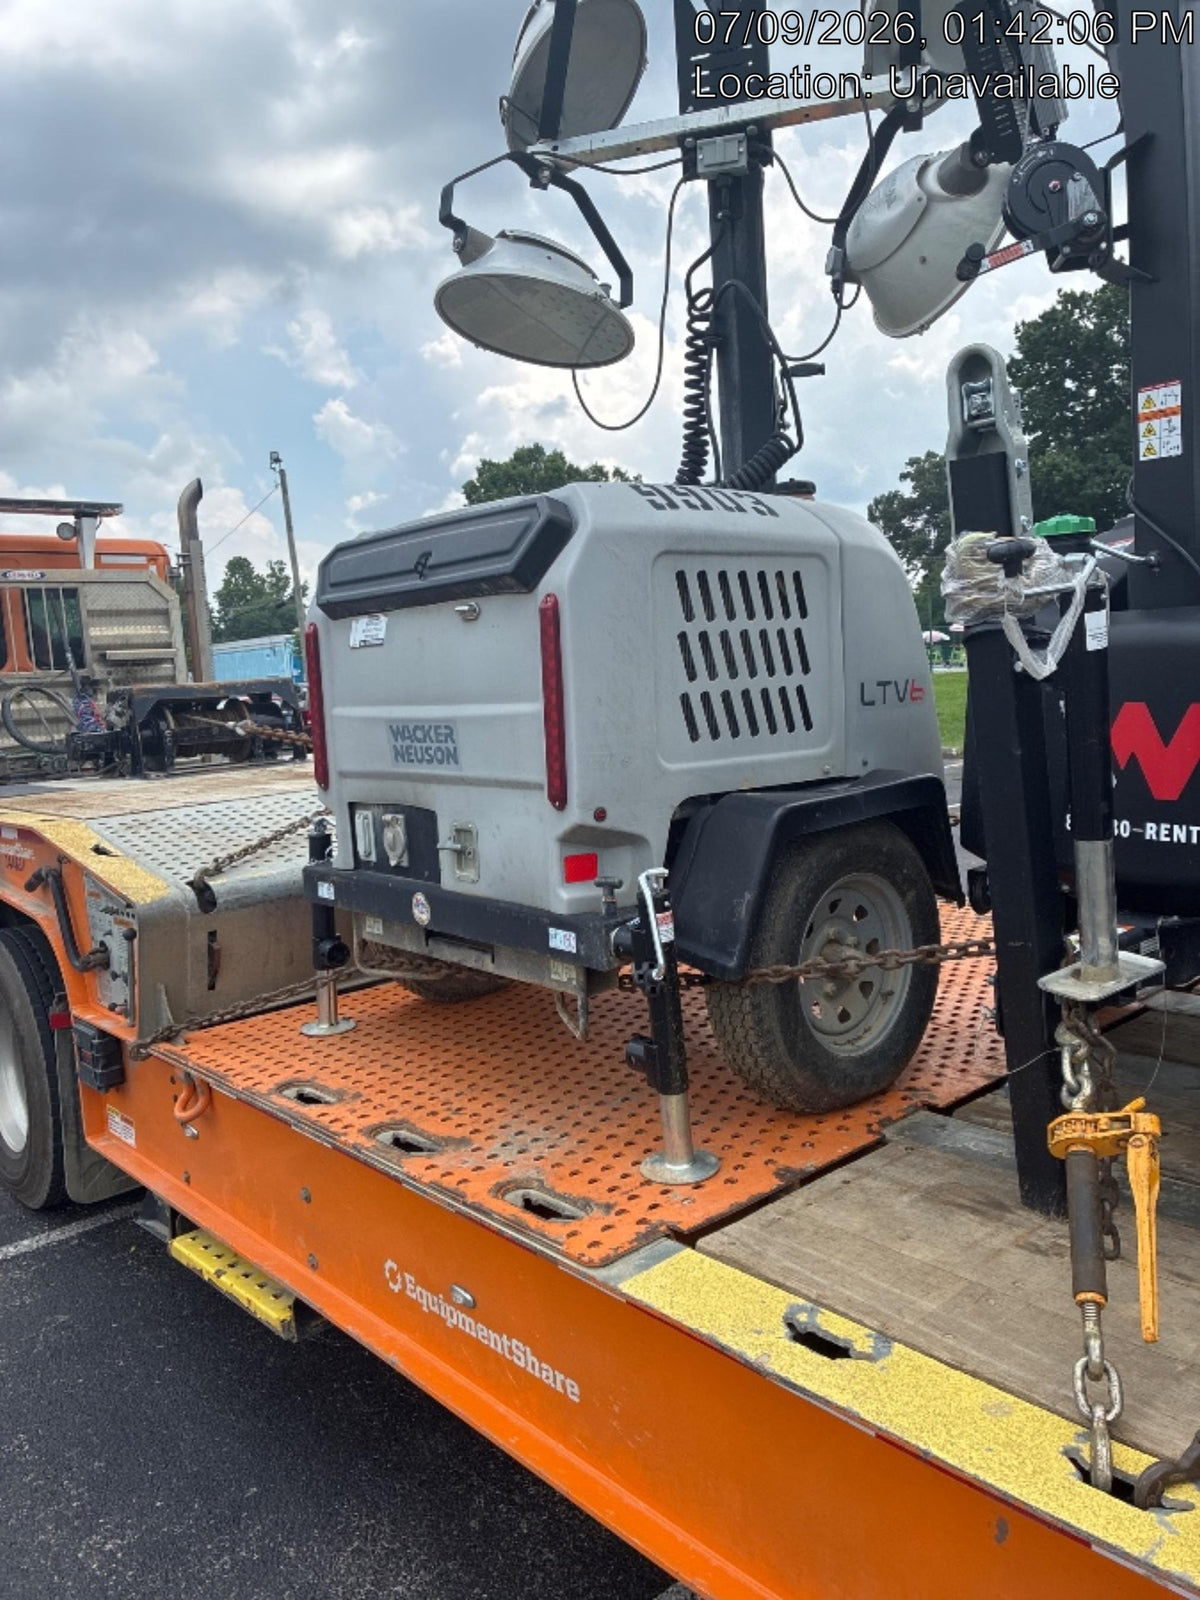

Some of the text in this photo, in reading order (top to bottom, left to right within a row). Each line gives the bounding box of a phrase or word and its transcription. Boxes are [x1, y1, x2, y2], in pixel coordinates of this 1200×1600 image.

[860, 679, 926, 706] LTV6
[388, 724, 456, 744] WACKER
[392, 743, 460, 765] NEUSON
[403, 1272, 581, 1404] EquipmentShare
